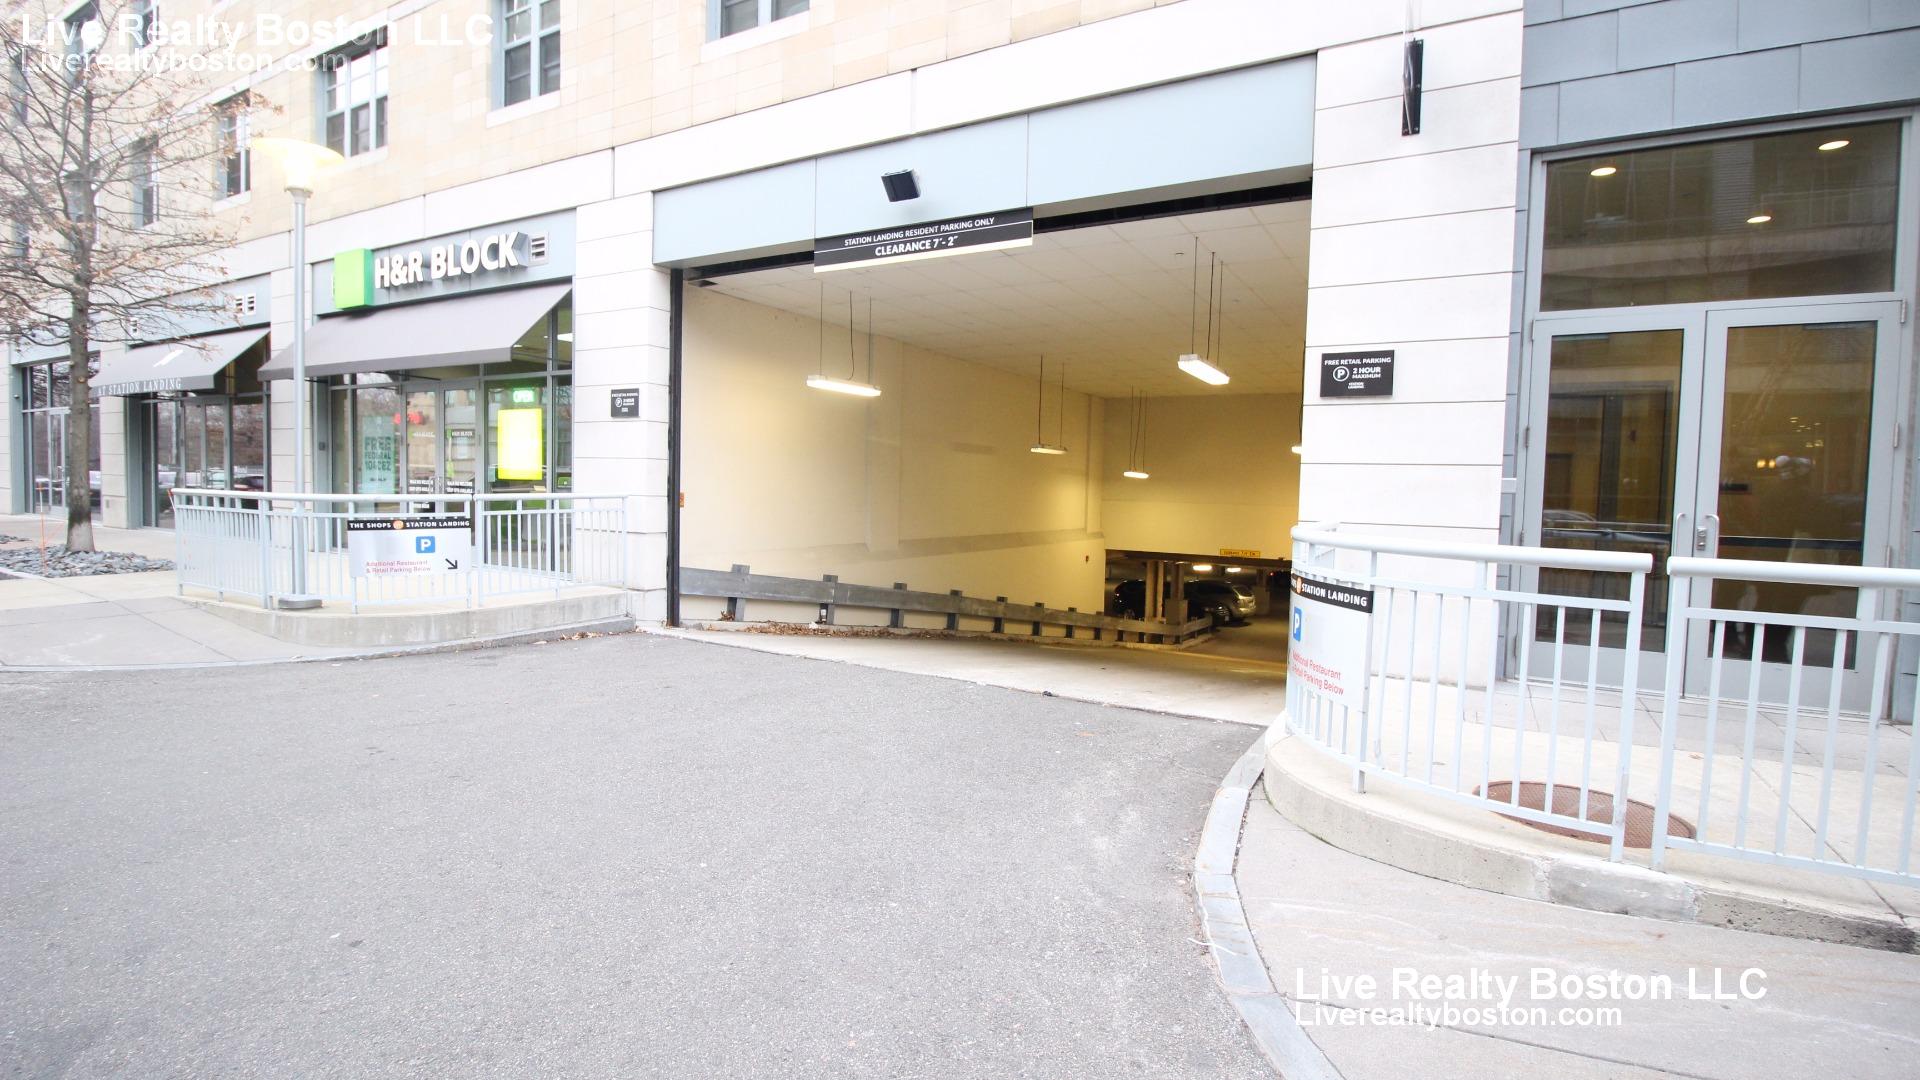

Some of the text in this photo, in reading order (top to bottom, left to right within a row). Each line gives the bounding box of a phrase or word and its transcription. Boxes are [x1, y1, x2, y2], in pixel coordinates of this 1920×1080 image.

[844, 217, 995, 247] STATION LANDING RESIDENT PARKING ONLY
[875, 238, 932, 257] CLEARANCE
[374, 231, 519, 289] H&R BLOCK
[1358, 366, 1381, 374] HOUR
[109, 381, 140, 395] STATION
[143, 378, 182, 393] LANDING
[406, 520, 437, 528] STATION
[439, 519, 470, 528] LANDING
[1301, 583, 1368, 607] STATION LANDING
[1323, 679, 1344, 695] Below
